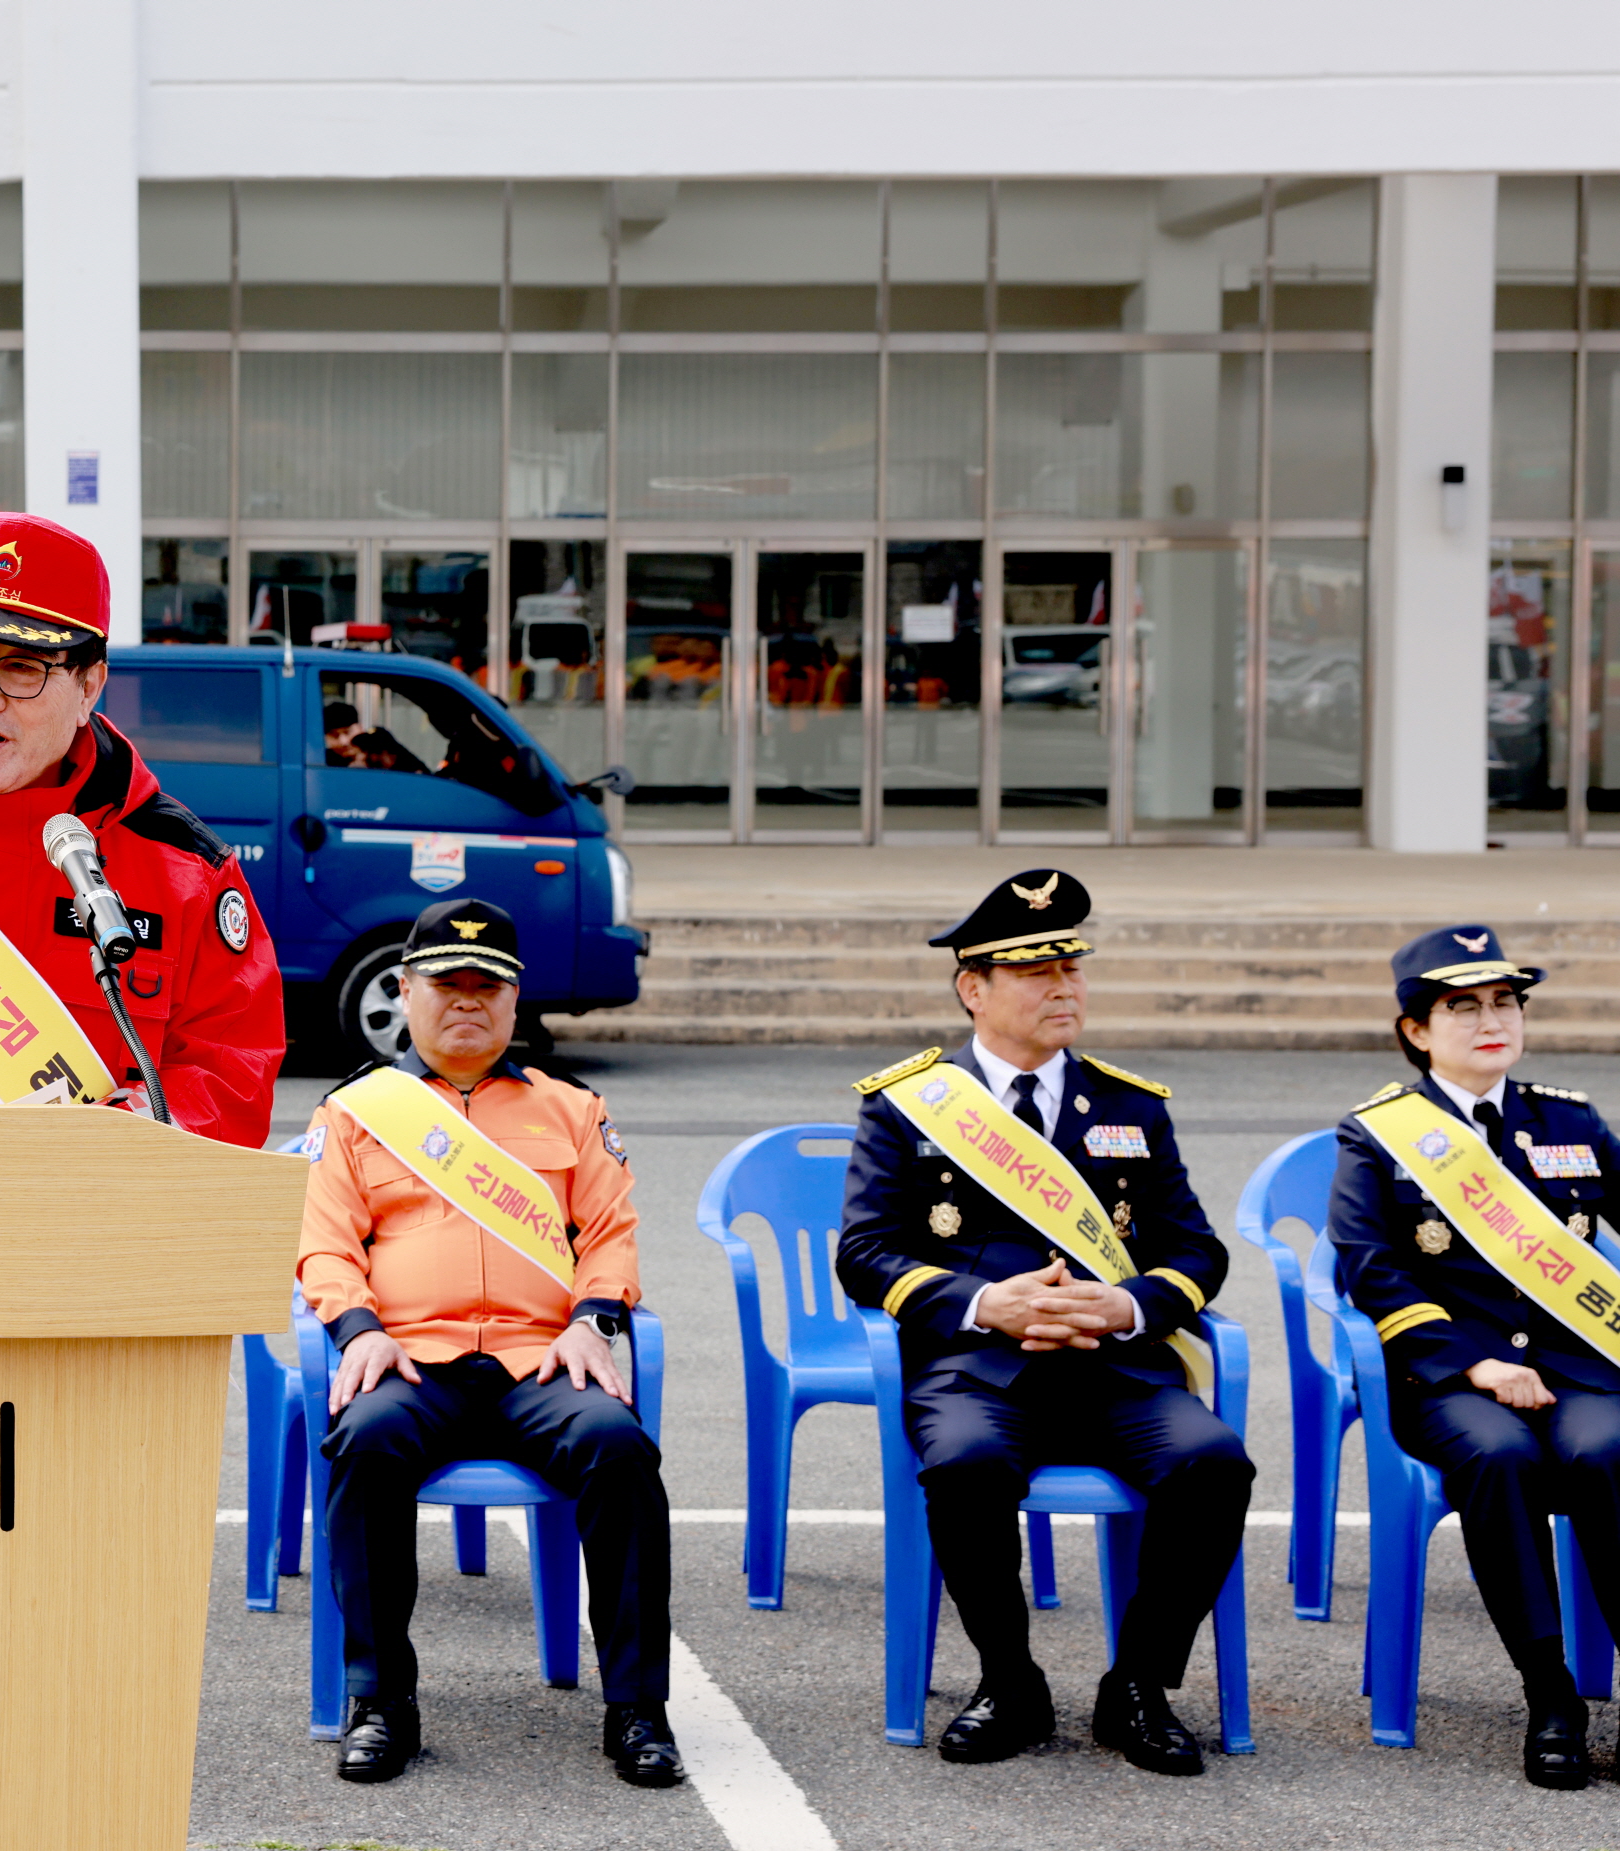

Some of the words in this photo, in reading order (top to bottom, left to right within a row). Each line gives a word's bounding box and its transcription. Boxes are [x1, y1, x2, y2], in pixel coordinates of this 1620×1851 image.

[233, 844, 264, 861] 119
[465, 1161, 568, 1258] 산불조심
[955, 1108, 1074, 1213] 산불조심
[1459, 1171, 1576, 1286] 산불조심
